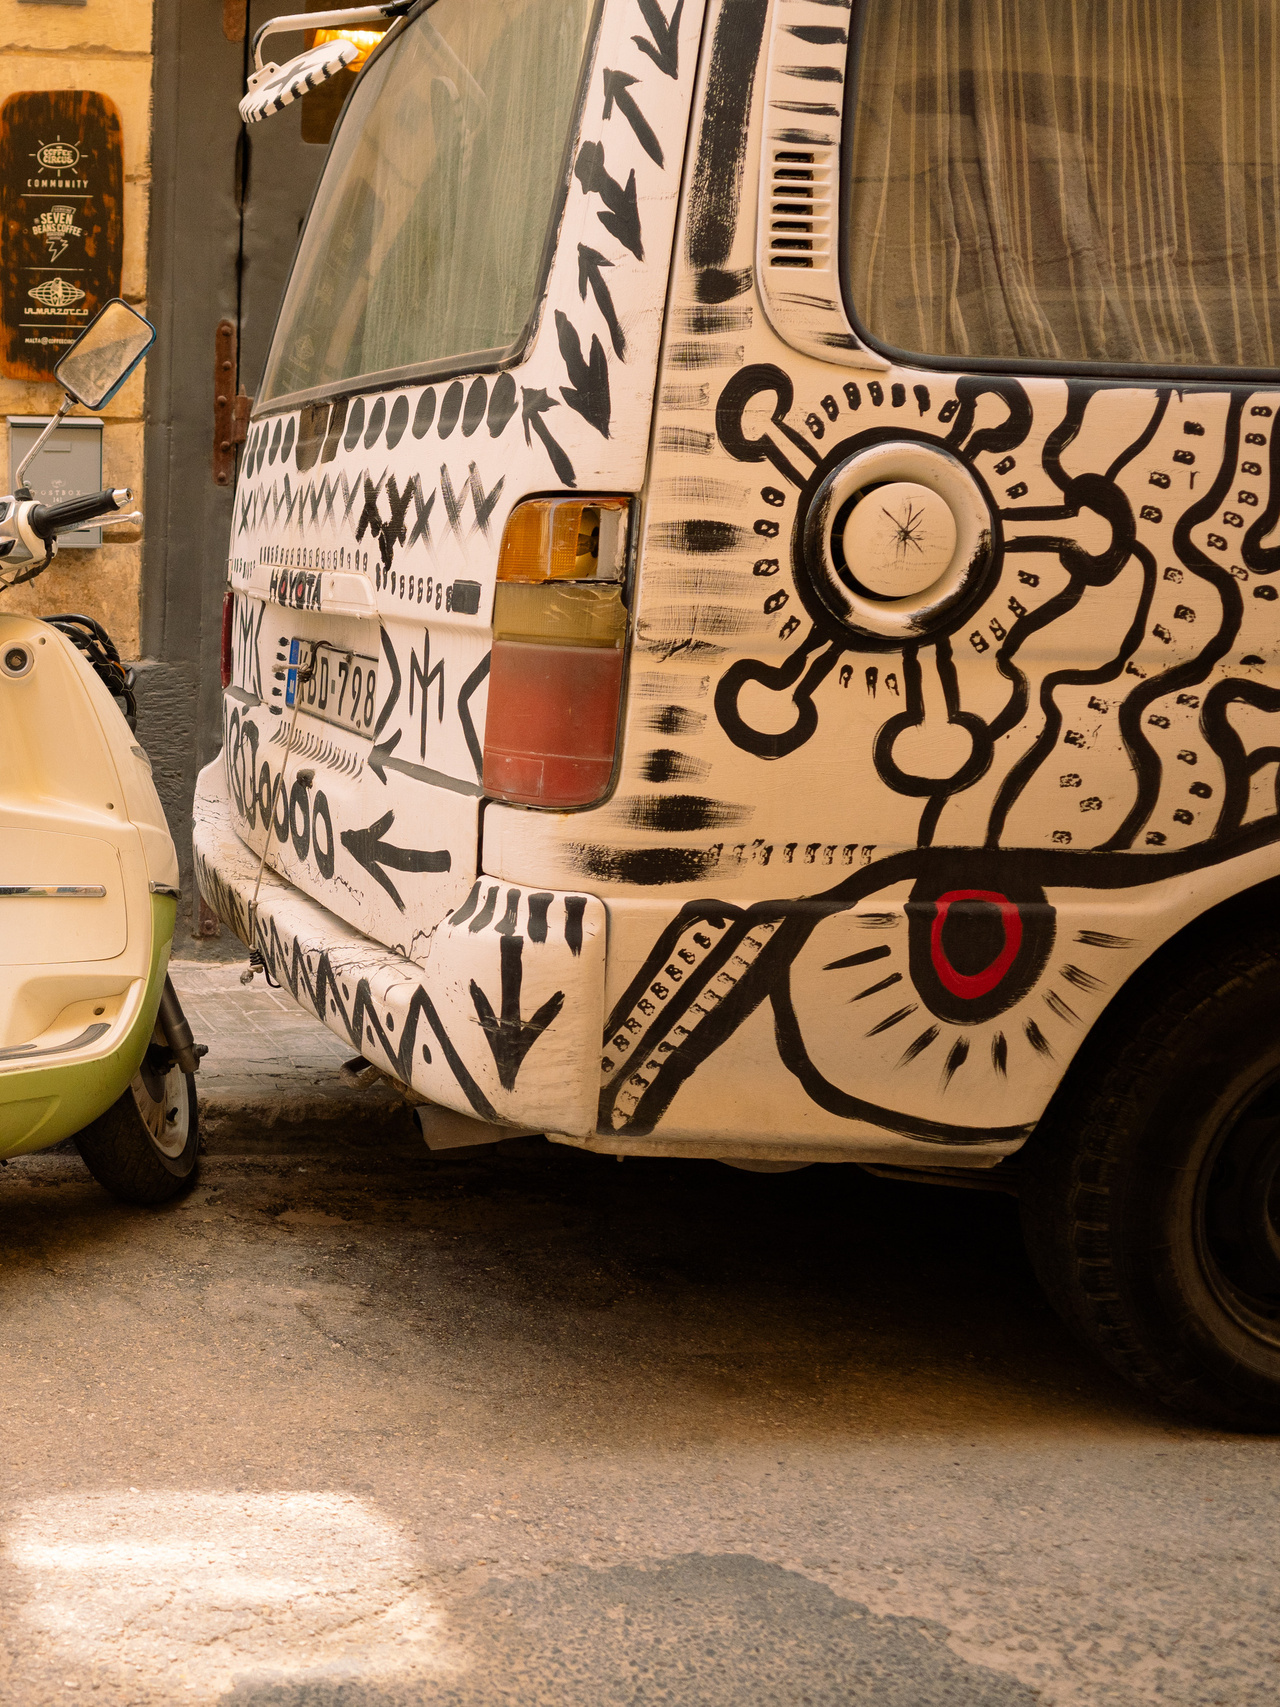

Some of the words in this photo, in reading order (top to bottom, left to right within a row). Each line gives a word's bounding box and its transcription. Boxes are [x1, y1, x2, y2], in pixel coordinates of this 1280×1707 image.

[43, 155, 74, 164] CIRCUS
[27, 178, 89, 189] COMMUNITY
[40, 212, 74, 225] SEVEN
[32, 223, 57, 235] BEANS
[57, 223, 83, 237] COFFEE
